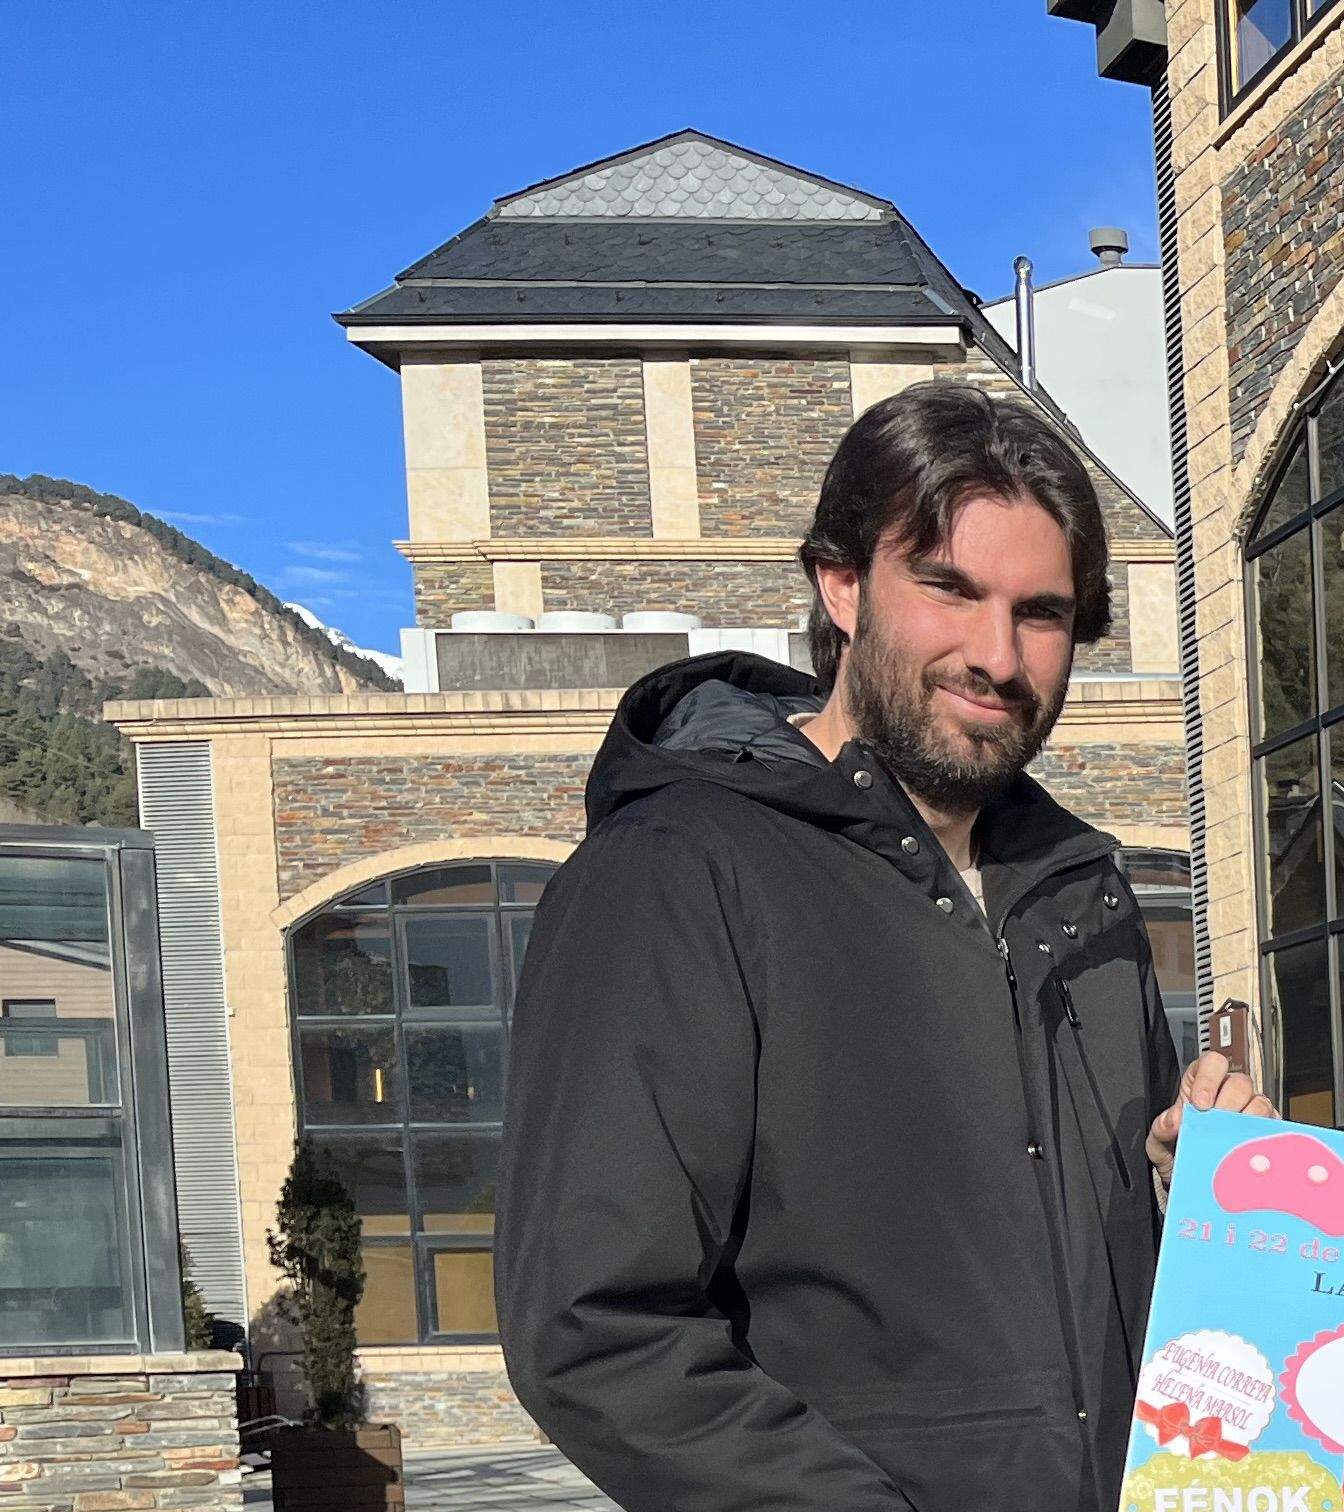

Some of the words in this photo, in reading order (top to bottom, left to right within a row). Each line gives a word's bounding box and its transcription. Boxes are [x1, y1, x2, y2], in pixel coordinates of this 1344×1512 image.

[1176, 1216, 1213, 1242] 21
[1224, 1223, 1236, 1247] i
[1247, 1229, 1292, 1256] 22
[1299, 1236, 1340, 1264] de
